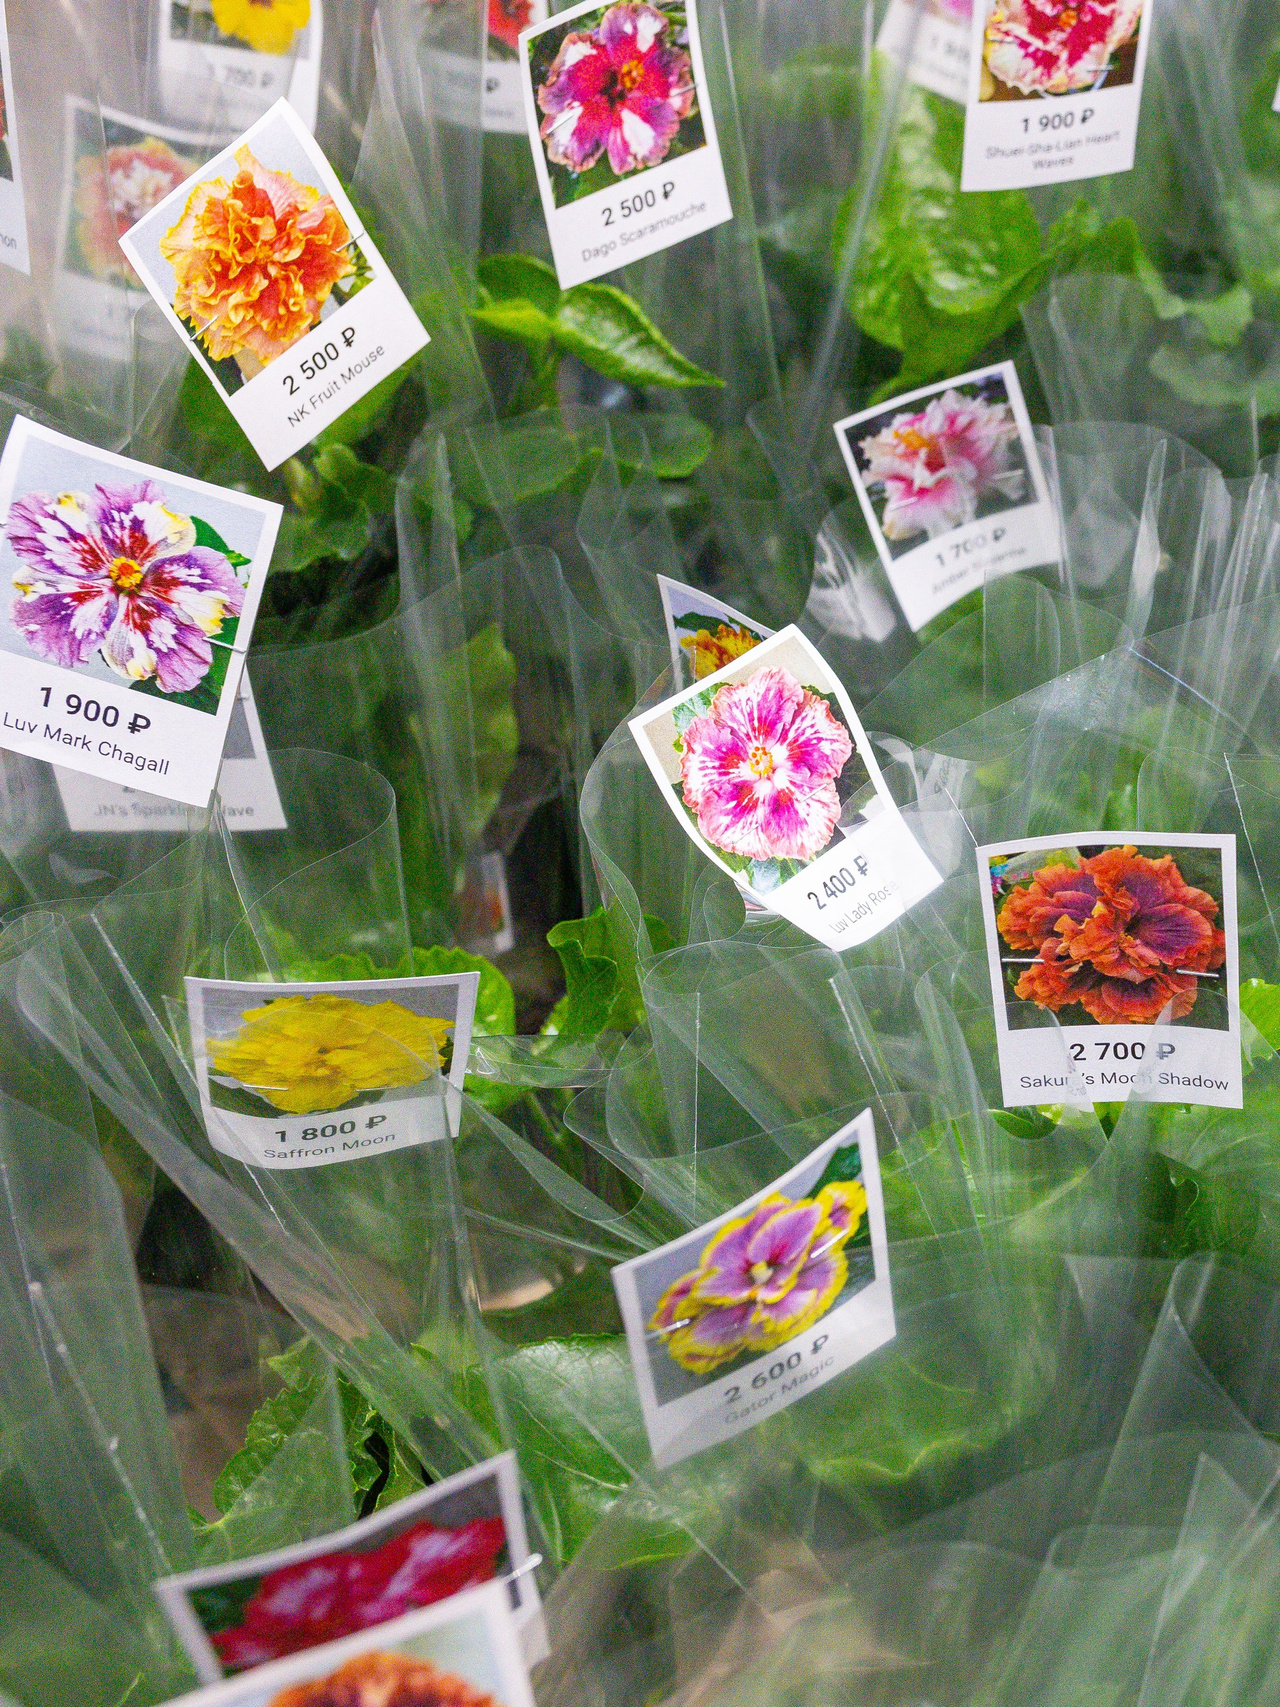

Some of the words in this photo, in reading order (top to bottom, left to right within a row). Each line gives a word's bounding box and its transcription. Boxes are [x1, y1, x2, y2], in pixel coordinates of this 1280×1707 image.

[1022, 117, 1029, 133] 1
[1039, 111, 1075, 132] 900
[602, 207, 615, 227] 2
[620, 189, 656, 218] 500
[662, 181, 676, 200] ₽
[581, 240, 617, 262] Dago
[619, 201, 707, 246] Scaramouche
[283, 375, 300, 396] 2
[300, 342, 339, 380] 500
[341, 327, 355, 348] ₽
[287, 404, 310, 428] NK
[309, 381, 341, 409] Fruit
[340, 345, 385, 384] Mouse
[937, 554, 945, 566] 1
[40, 687, 52, 708] 1
[65, 693, 120, 728] 900
[127, 713, 151, 735] ₽
[3, 712, 38, 734] Luv
[43, 724, 92, 752] Mark
[98, 741, 170, 775] Chagall
[807, 891, 827, 911] 2
[822, 867, 856, 899] 400
[828, 919, 849, 934] Luv
[843, 902, 874, 925] Lady
[1069, 1043, 1087, 1062] 2
[1094, 1041, 1146, 1061] 700
[1155, 1042, 1176, 1060] ₽
[1158, 1072, 1229, 1091] Shadow
[263, 1146, 335, 1159] Saffron
[342, 1134, 395, 1151] Moon
[275, 1130, 287, 1143] 1
[301, 1120, 356, 1141] 800
[365, 1115, 387, 1129] ₽
[725, 1386, 741, 1403] 2
[752, 1352, 801, 1389] 600
[781, 1356, 834, 1395] Magic
